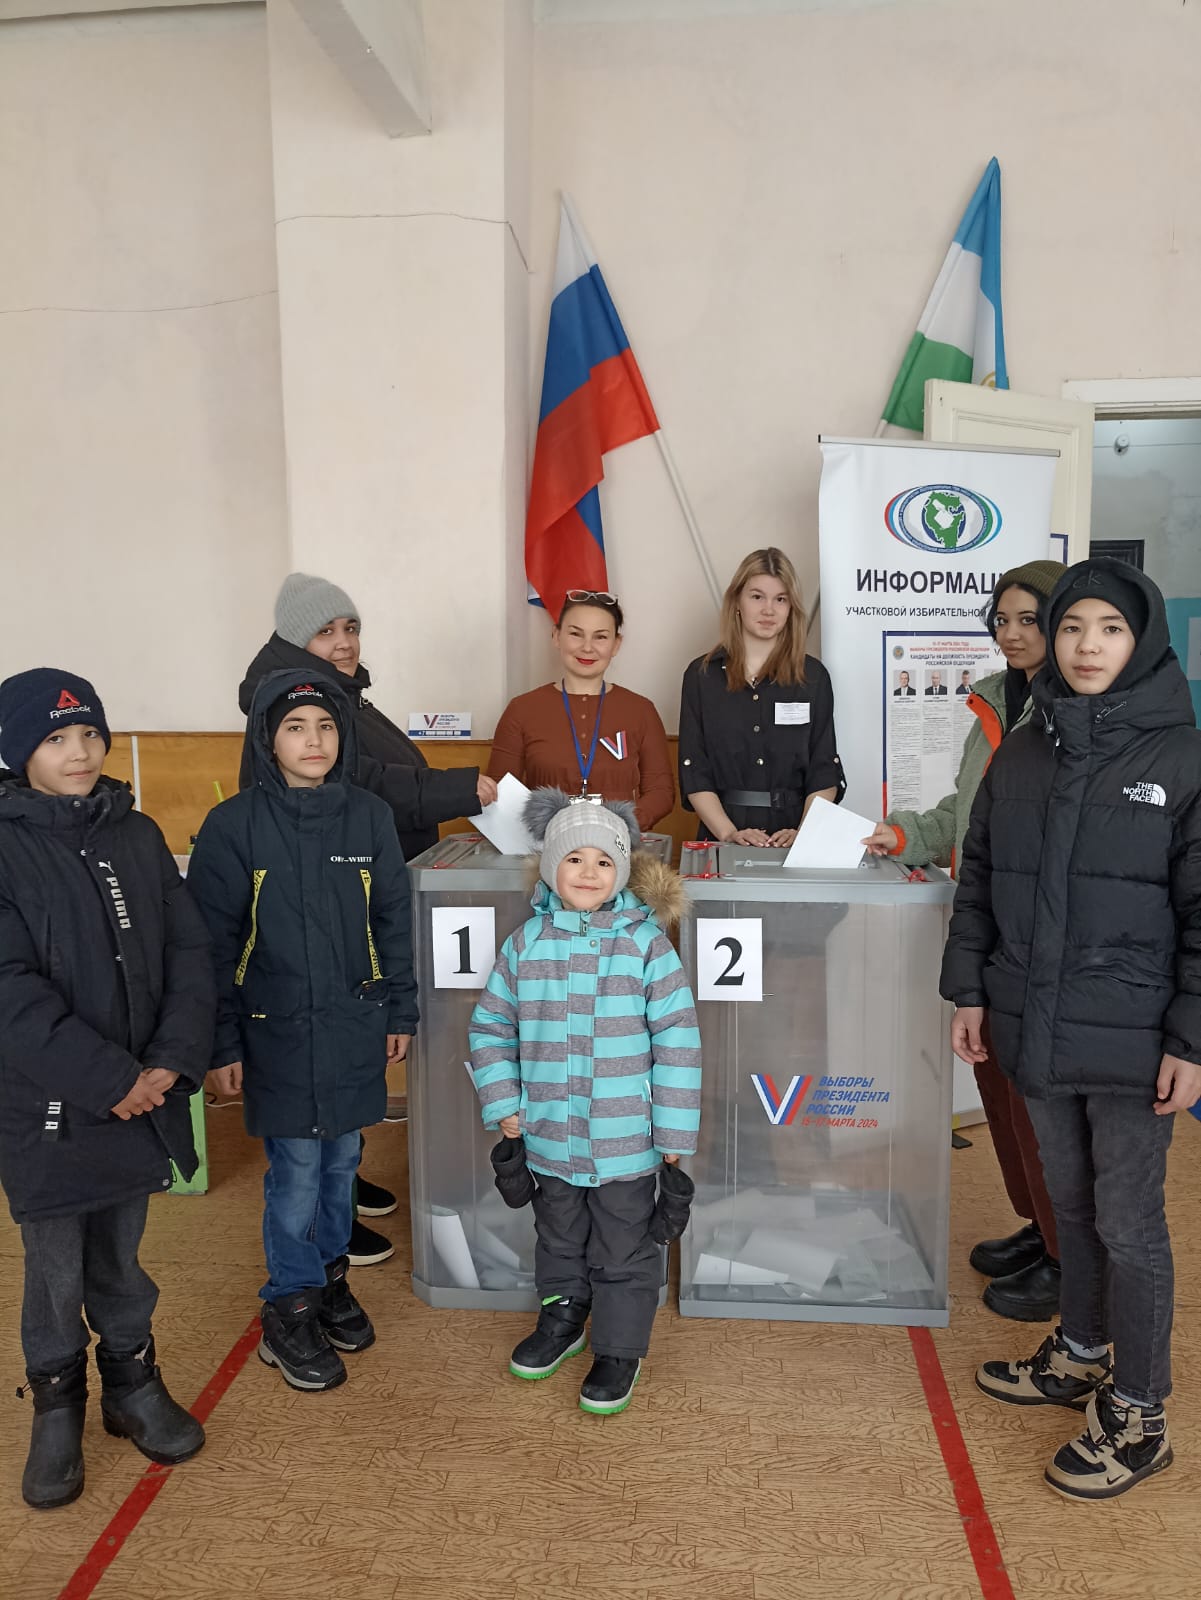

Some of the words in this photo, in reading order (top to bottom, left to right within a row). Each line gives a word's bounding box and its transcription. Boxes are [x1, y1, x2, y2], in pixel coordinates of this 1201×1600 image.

[856, 568, 1002, 595] ИНФОРМАЦ
[845, 606, 907, 617] УЧАСТКОВОЙ
[1135, 781, 1154, 790] THE
[451, 926, 478, 974] 1
[713, 937, 745, 986] 2
[819, 1076, 874, 1088] ВЫБОРЫ
[812, 1089, 890, 1103] ПРЕЗИДЕНТА
[805, 1103, 856, 1116] РОССИИ
[826, 1117, 856, 1128] МАРТА
[857, 1119, 879, 1129] 2024
